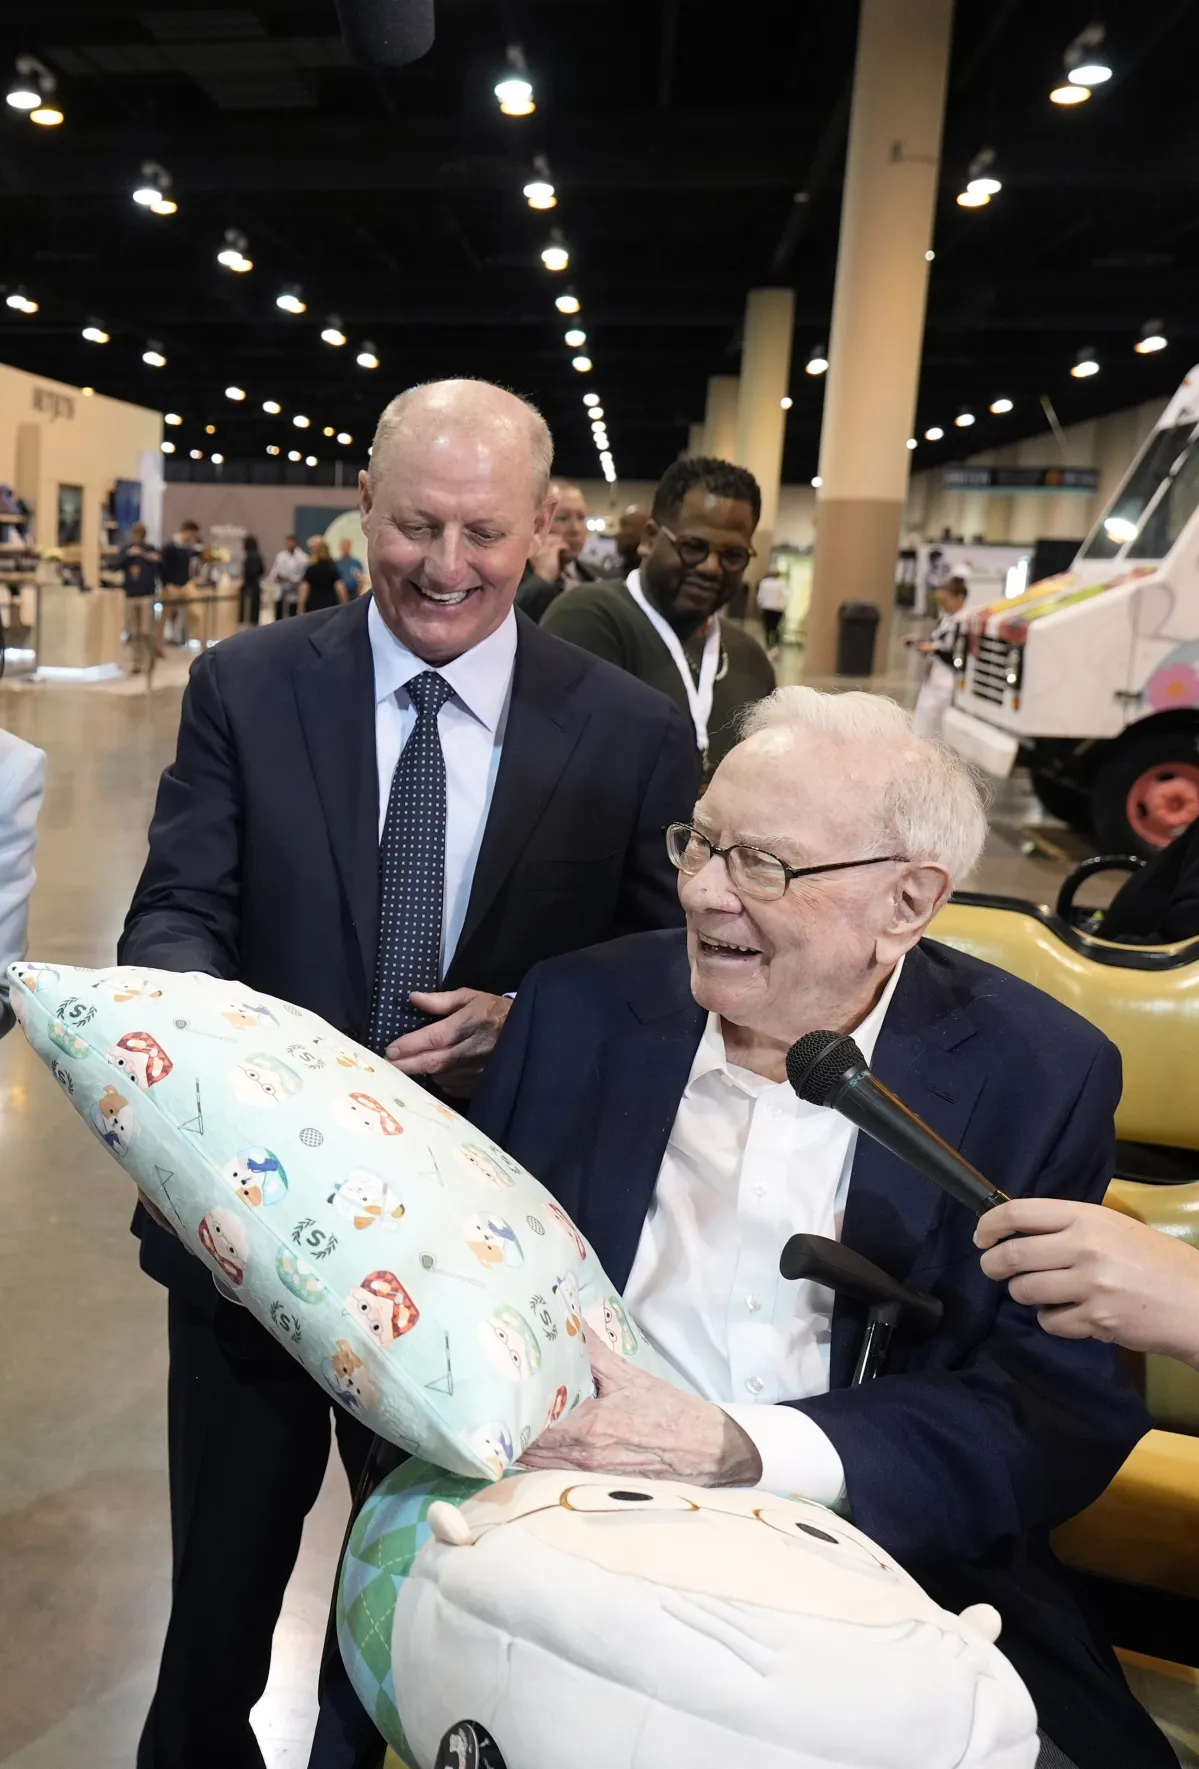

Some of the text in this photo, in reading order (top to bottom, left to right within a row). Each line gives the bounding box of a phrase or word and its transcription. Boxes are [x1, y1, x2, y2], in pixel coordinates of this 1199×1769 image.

[69, 1003, 87, 1018] S
[299, 1052, 315, 1061] S
[850, 1070, 870, 1087] SHUR
[306, 1229, 326, 1247] S
[280, 1313, 290, 1331] S
[540, 1310, 552, 1326] S
